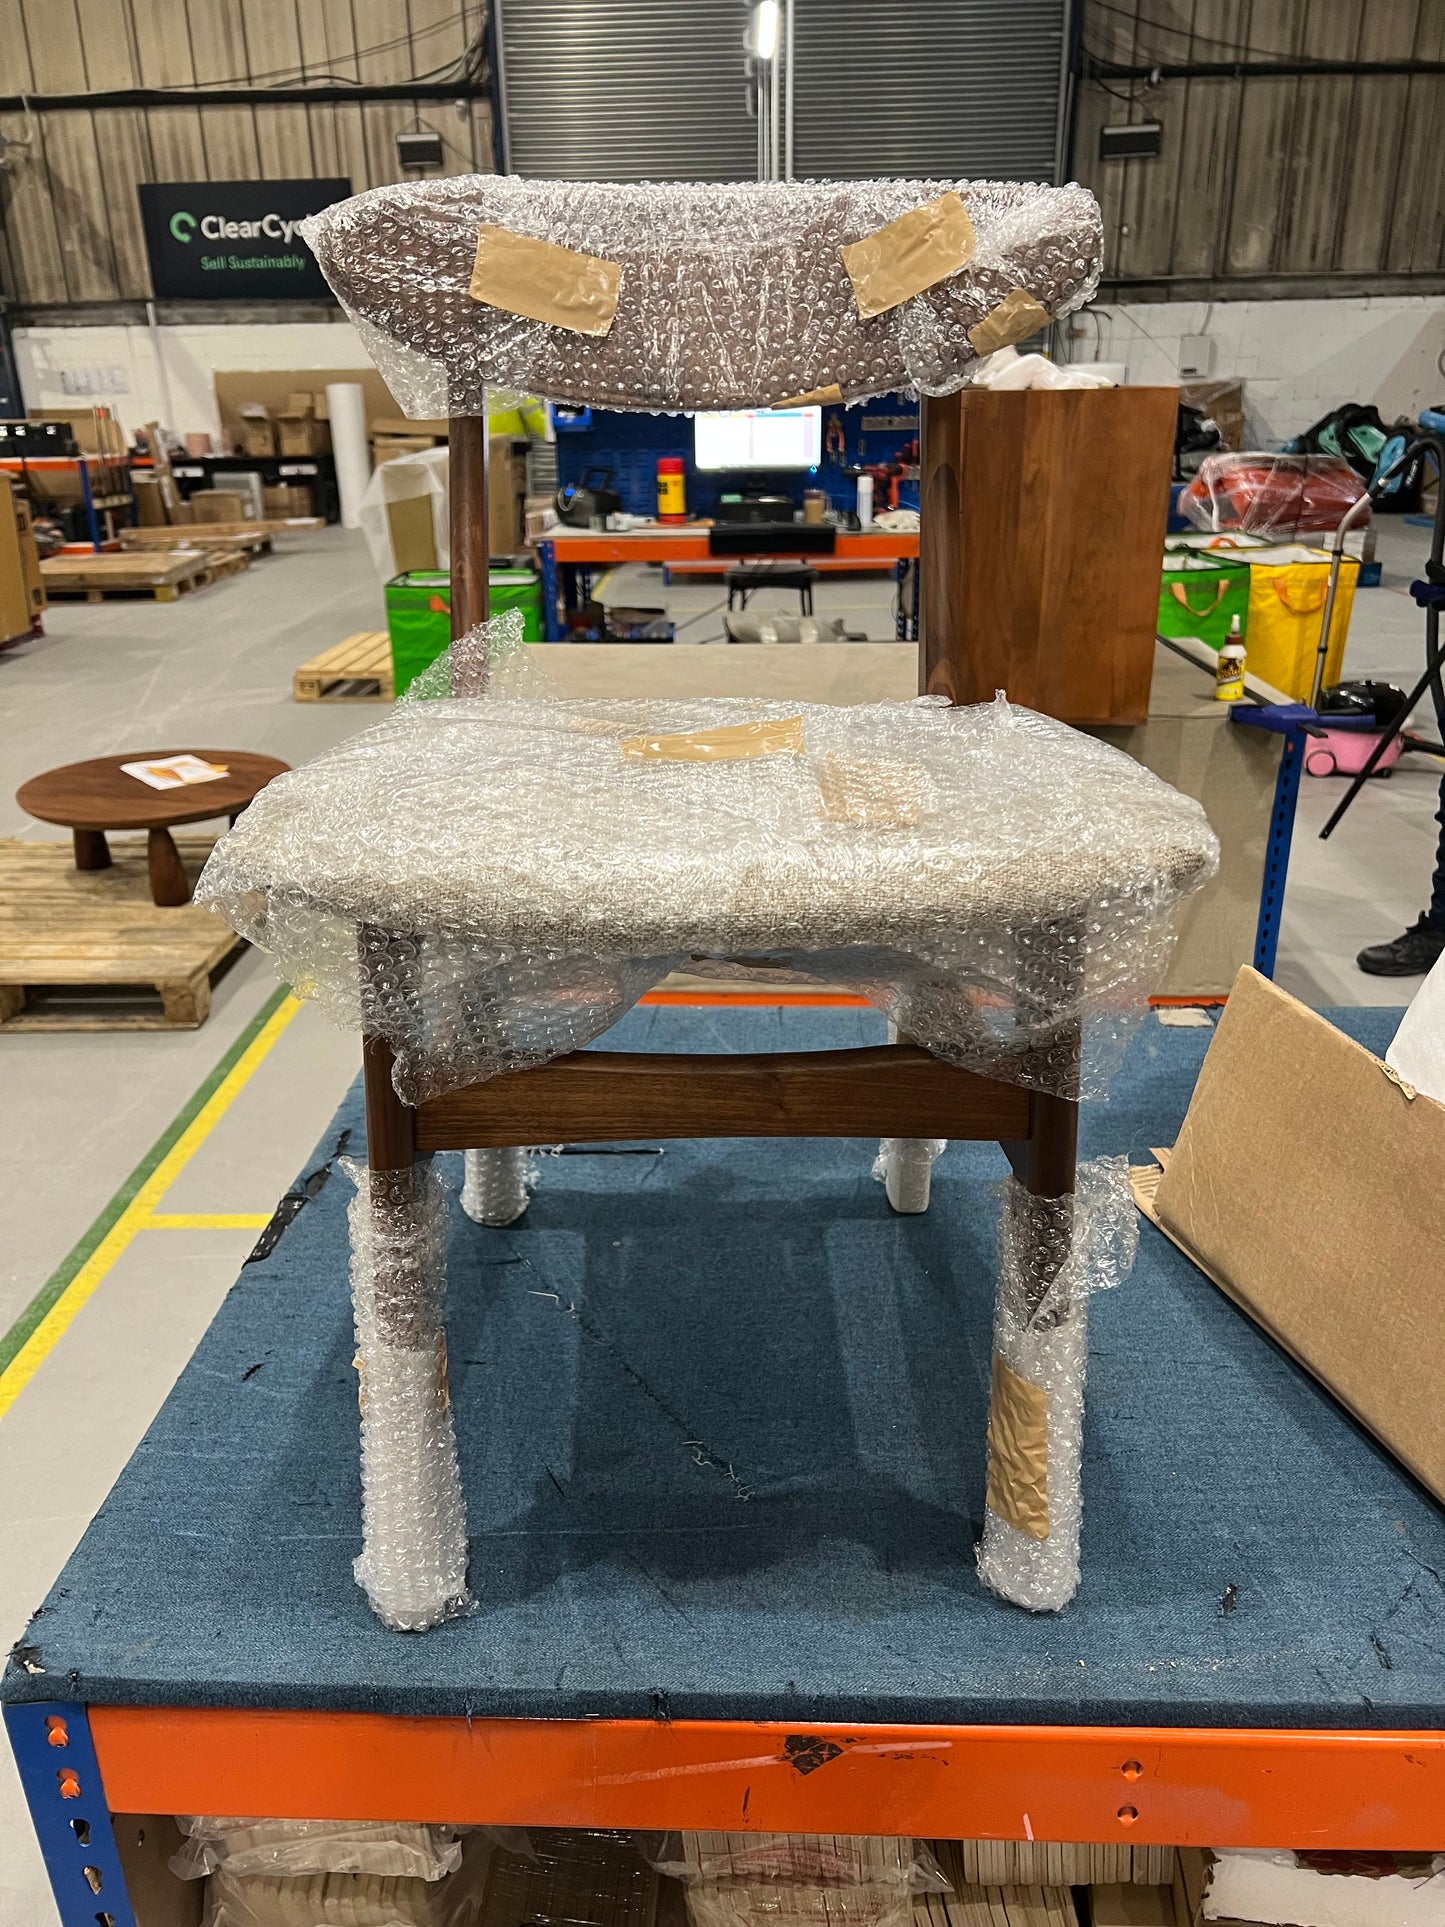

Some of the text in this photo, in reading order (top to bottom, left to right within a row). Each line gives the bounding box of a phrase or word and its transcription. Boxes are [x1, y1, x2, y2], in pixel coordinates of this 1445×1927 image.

[200, 213, 307, 244] ClearCyc
[200, 254, 306, 272] Sell Sustainably
